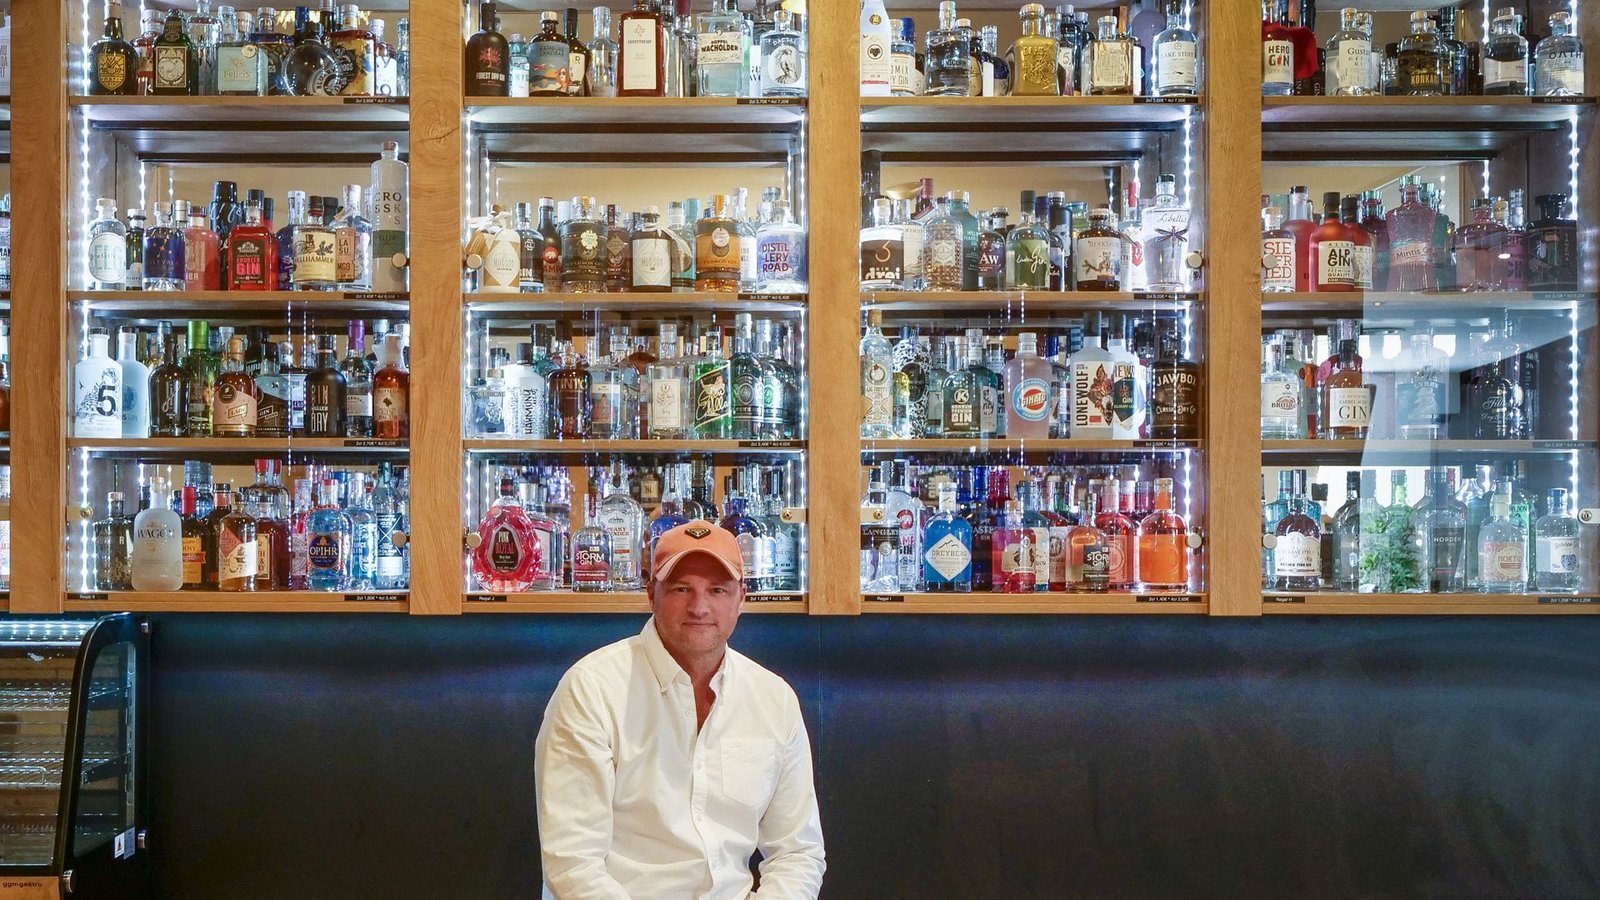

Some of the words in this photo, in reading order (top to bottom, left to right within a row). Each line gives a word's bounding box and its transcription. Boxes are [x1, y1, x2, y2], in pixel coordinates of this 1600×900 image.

[701, 44, 739, 52] WACHOLDER
[1268, 45, 1290, 54] HERO
[1548, 50, 1582, 59] OATH
[476, 72, 491, 80] FOREST
[1263, 242, 1292, 255] SIE
[1327, 257, 1351, 267] GIN
[237, 262, 261, 275] GIN
[763, 263, 789, 273] ROAD
[96, 385, 116, 417] 5
[1076, 371, 1089, 426] LONEWOLF
[1338, 405, 1368, 420] GIN
[311, 412, 328, 432] DRY
[951, 413, 972, 423] GIN
[309, 546, 338, 556] OPIHR
[576, 550, 605, 562] STORM
